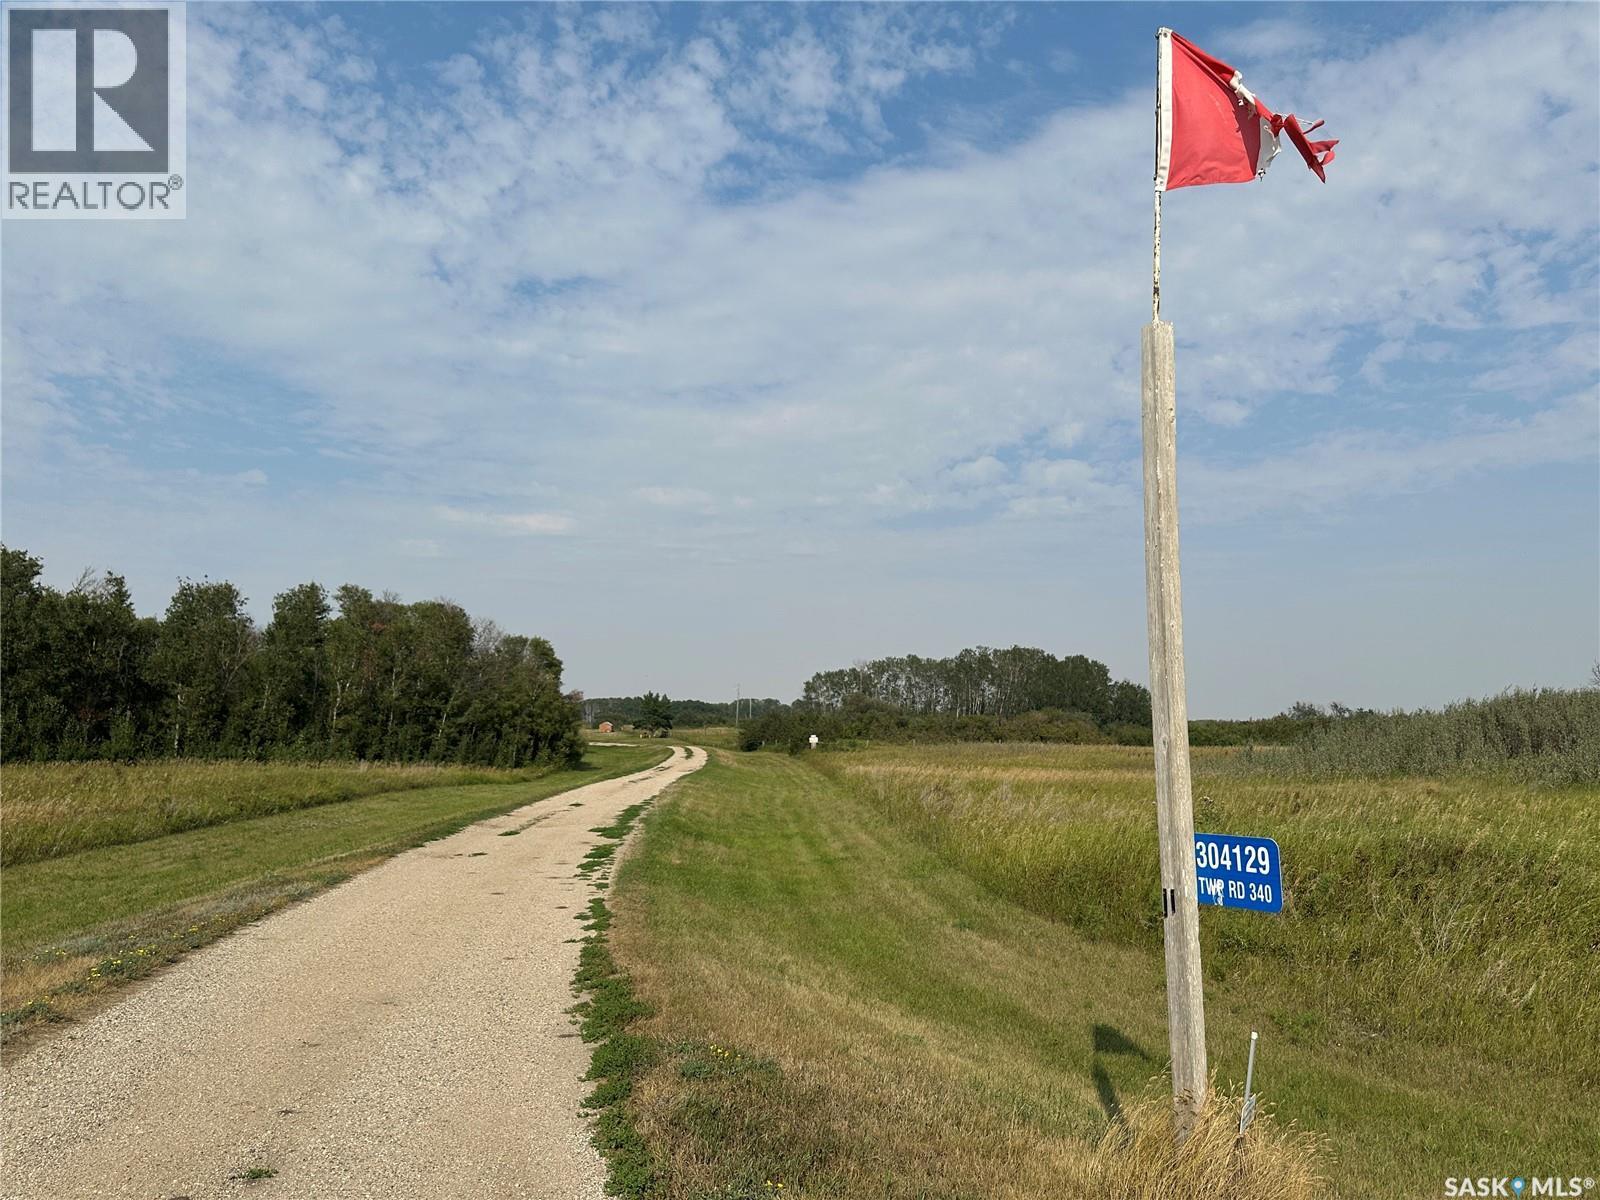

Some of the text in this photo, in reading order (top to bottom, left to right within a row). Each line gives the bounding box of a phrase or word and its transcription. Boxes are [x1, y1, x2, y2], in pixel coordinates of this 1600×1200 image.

[1195, 841, 1270, 875] 304129
[1228, 880, 1246, 900] RD
[1249, 882, 1273, 904] 340
